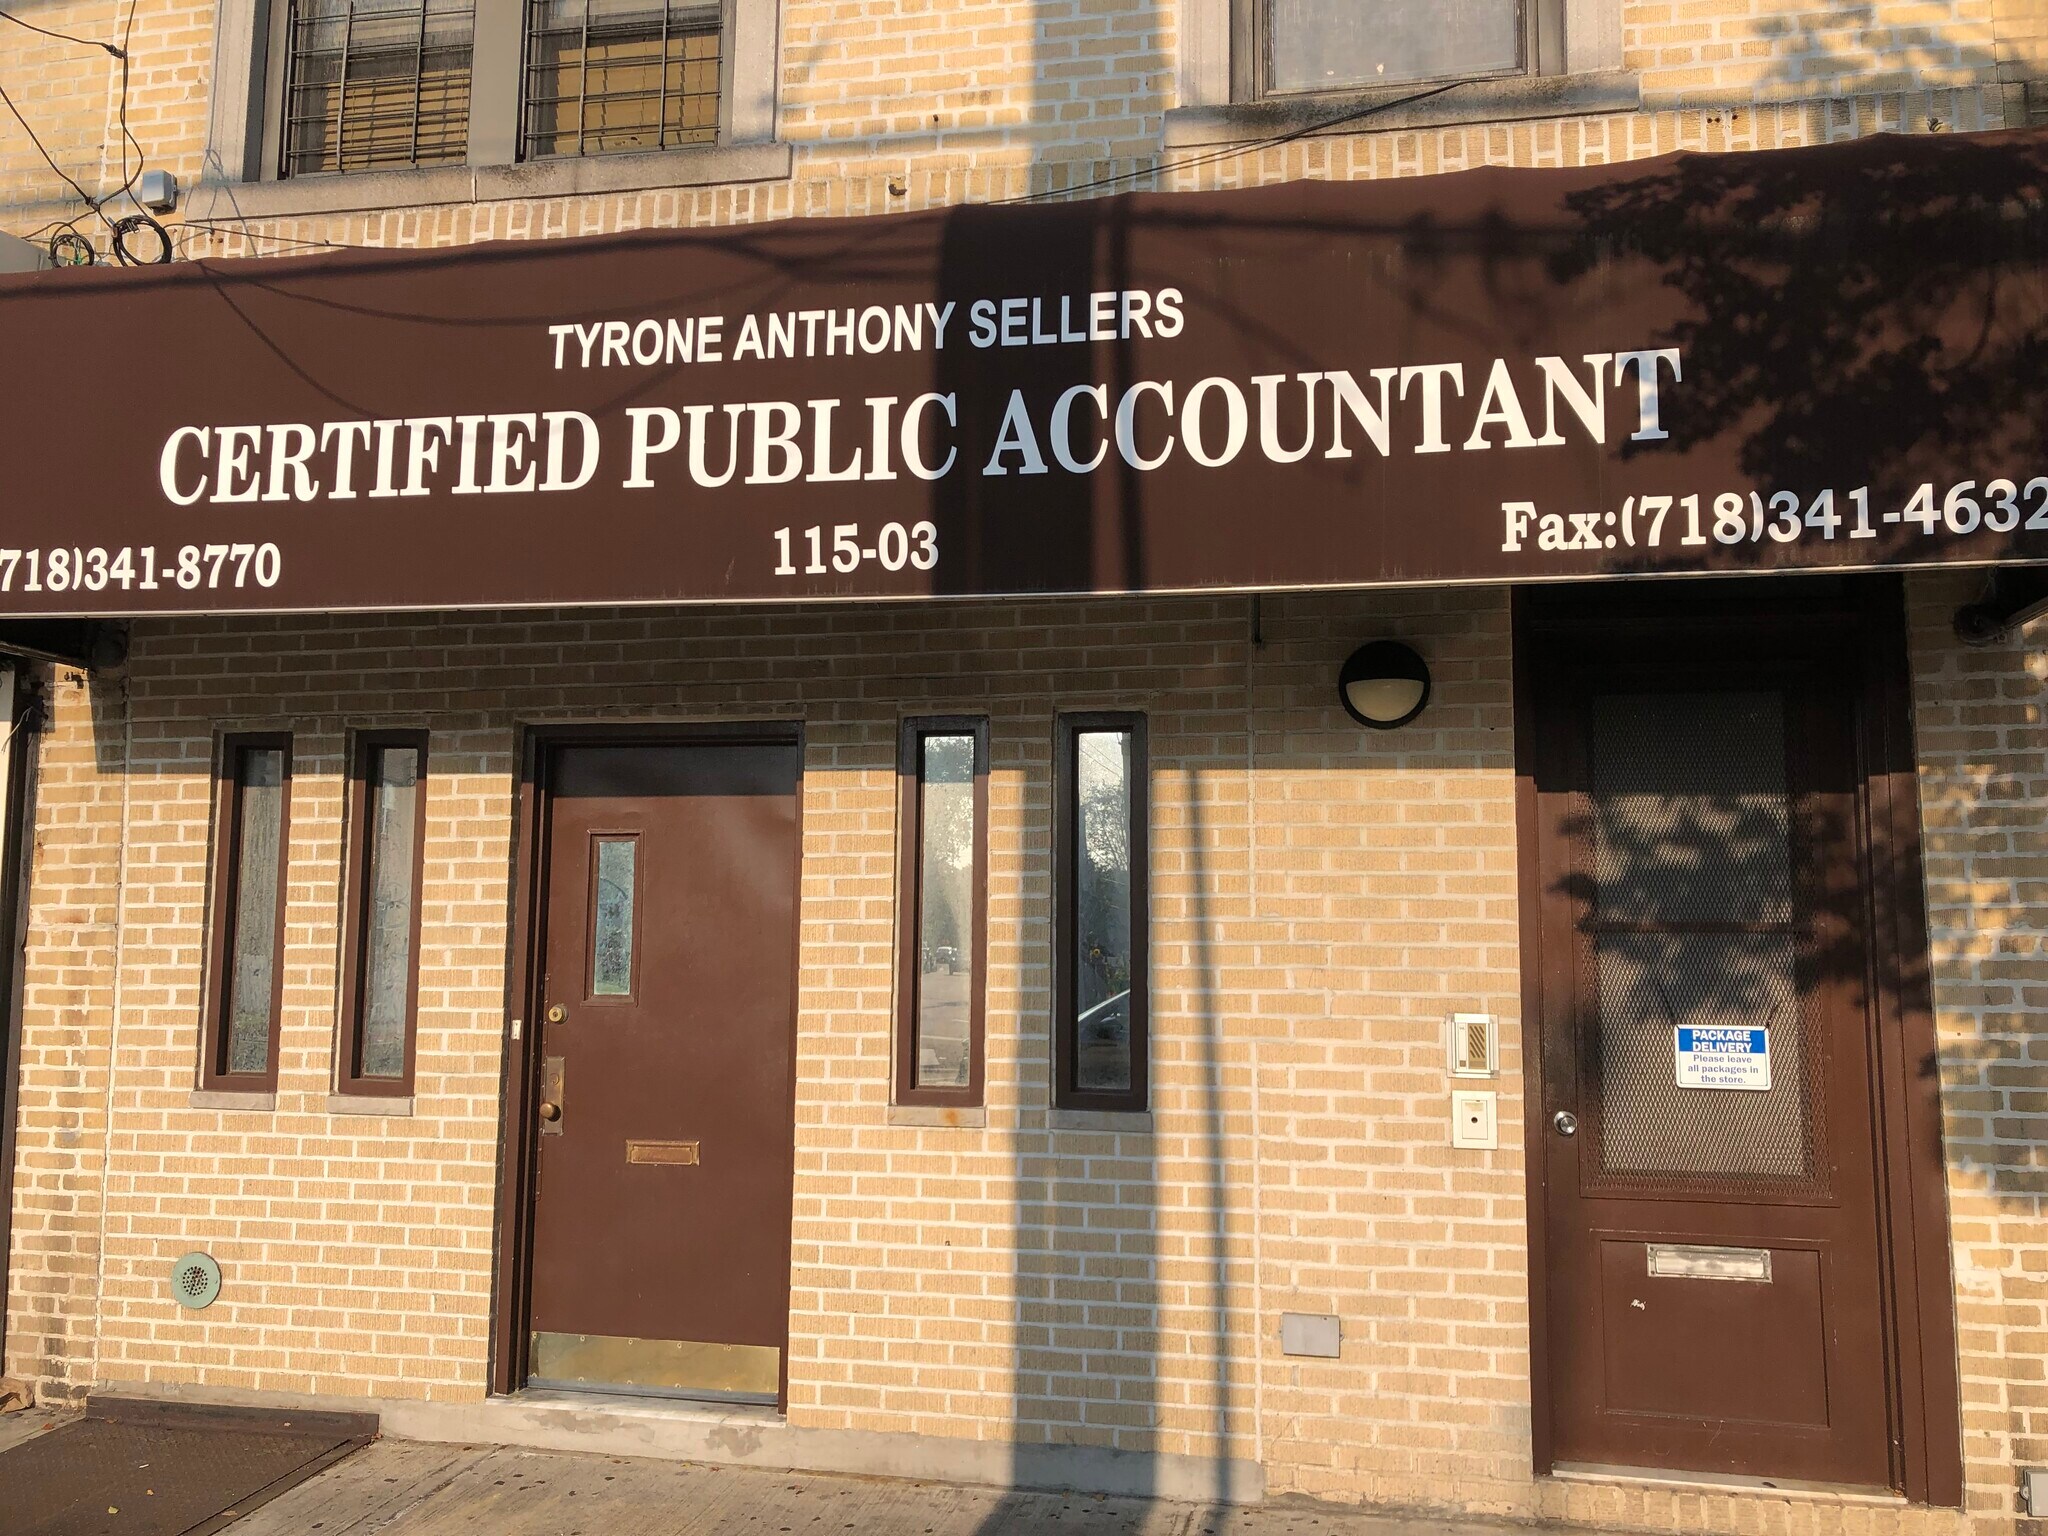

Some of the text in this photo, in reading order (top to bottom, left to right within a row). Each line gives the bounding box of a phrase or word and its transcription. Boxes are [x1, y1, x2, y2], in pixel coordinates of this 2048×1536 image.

[548, 287, 1185, 372] TYRONE ANTHONY SELLERS
[158, 347, 1682, 507] CERTIFIED PUBLIC ACCOUNTANT
[774, 520, 939, 577] 115-03
[1692, 1030, 1751, 1042] PACKAGE
[1692, 1042, 1752, 1053] DELIVERY
[1693, 1054, 1752, 1064] Please leave
[1701, 1065, 1747, 1075] packages
[1750, 1066, 1759, 1074] in
[1701, 1075, 1746, 1084] the store.
